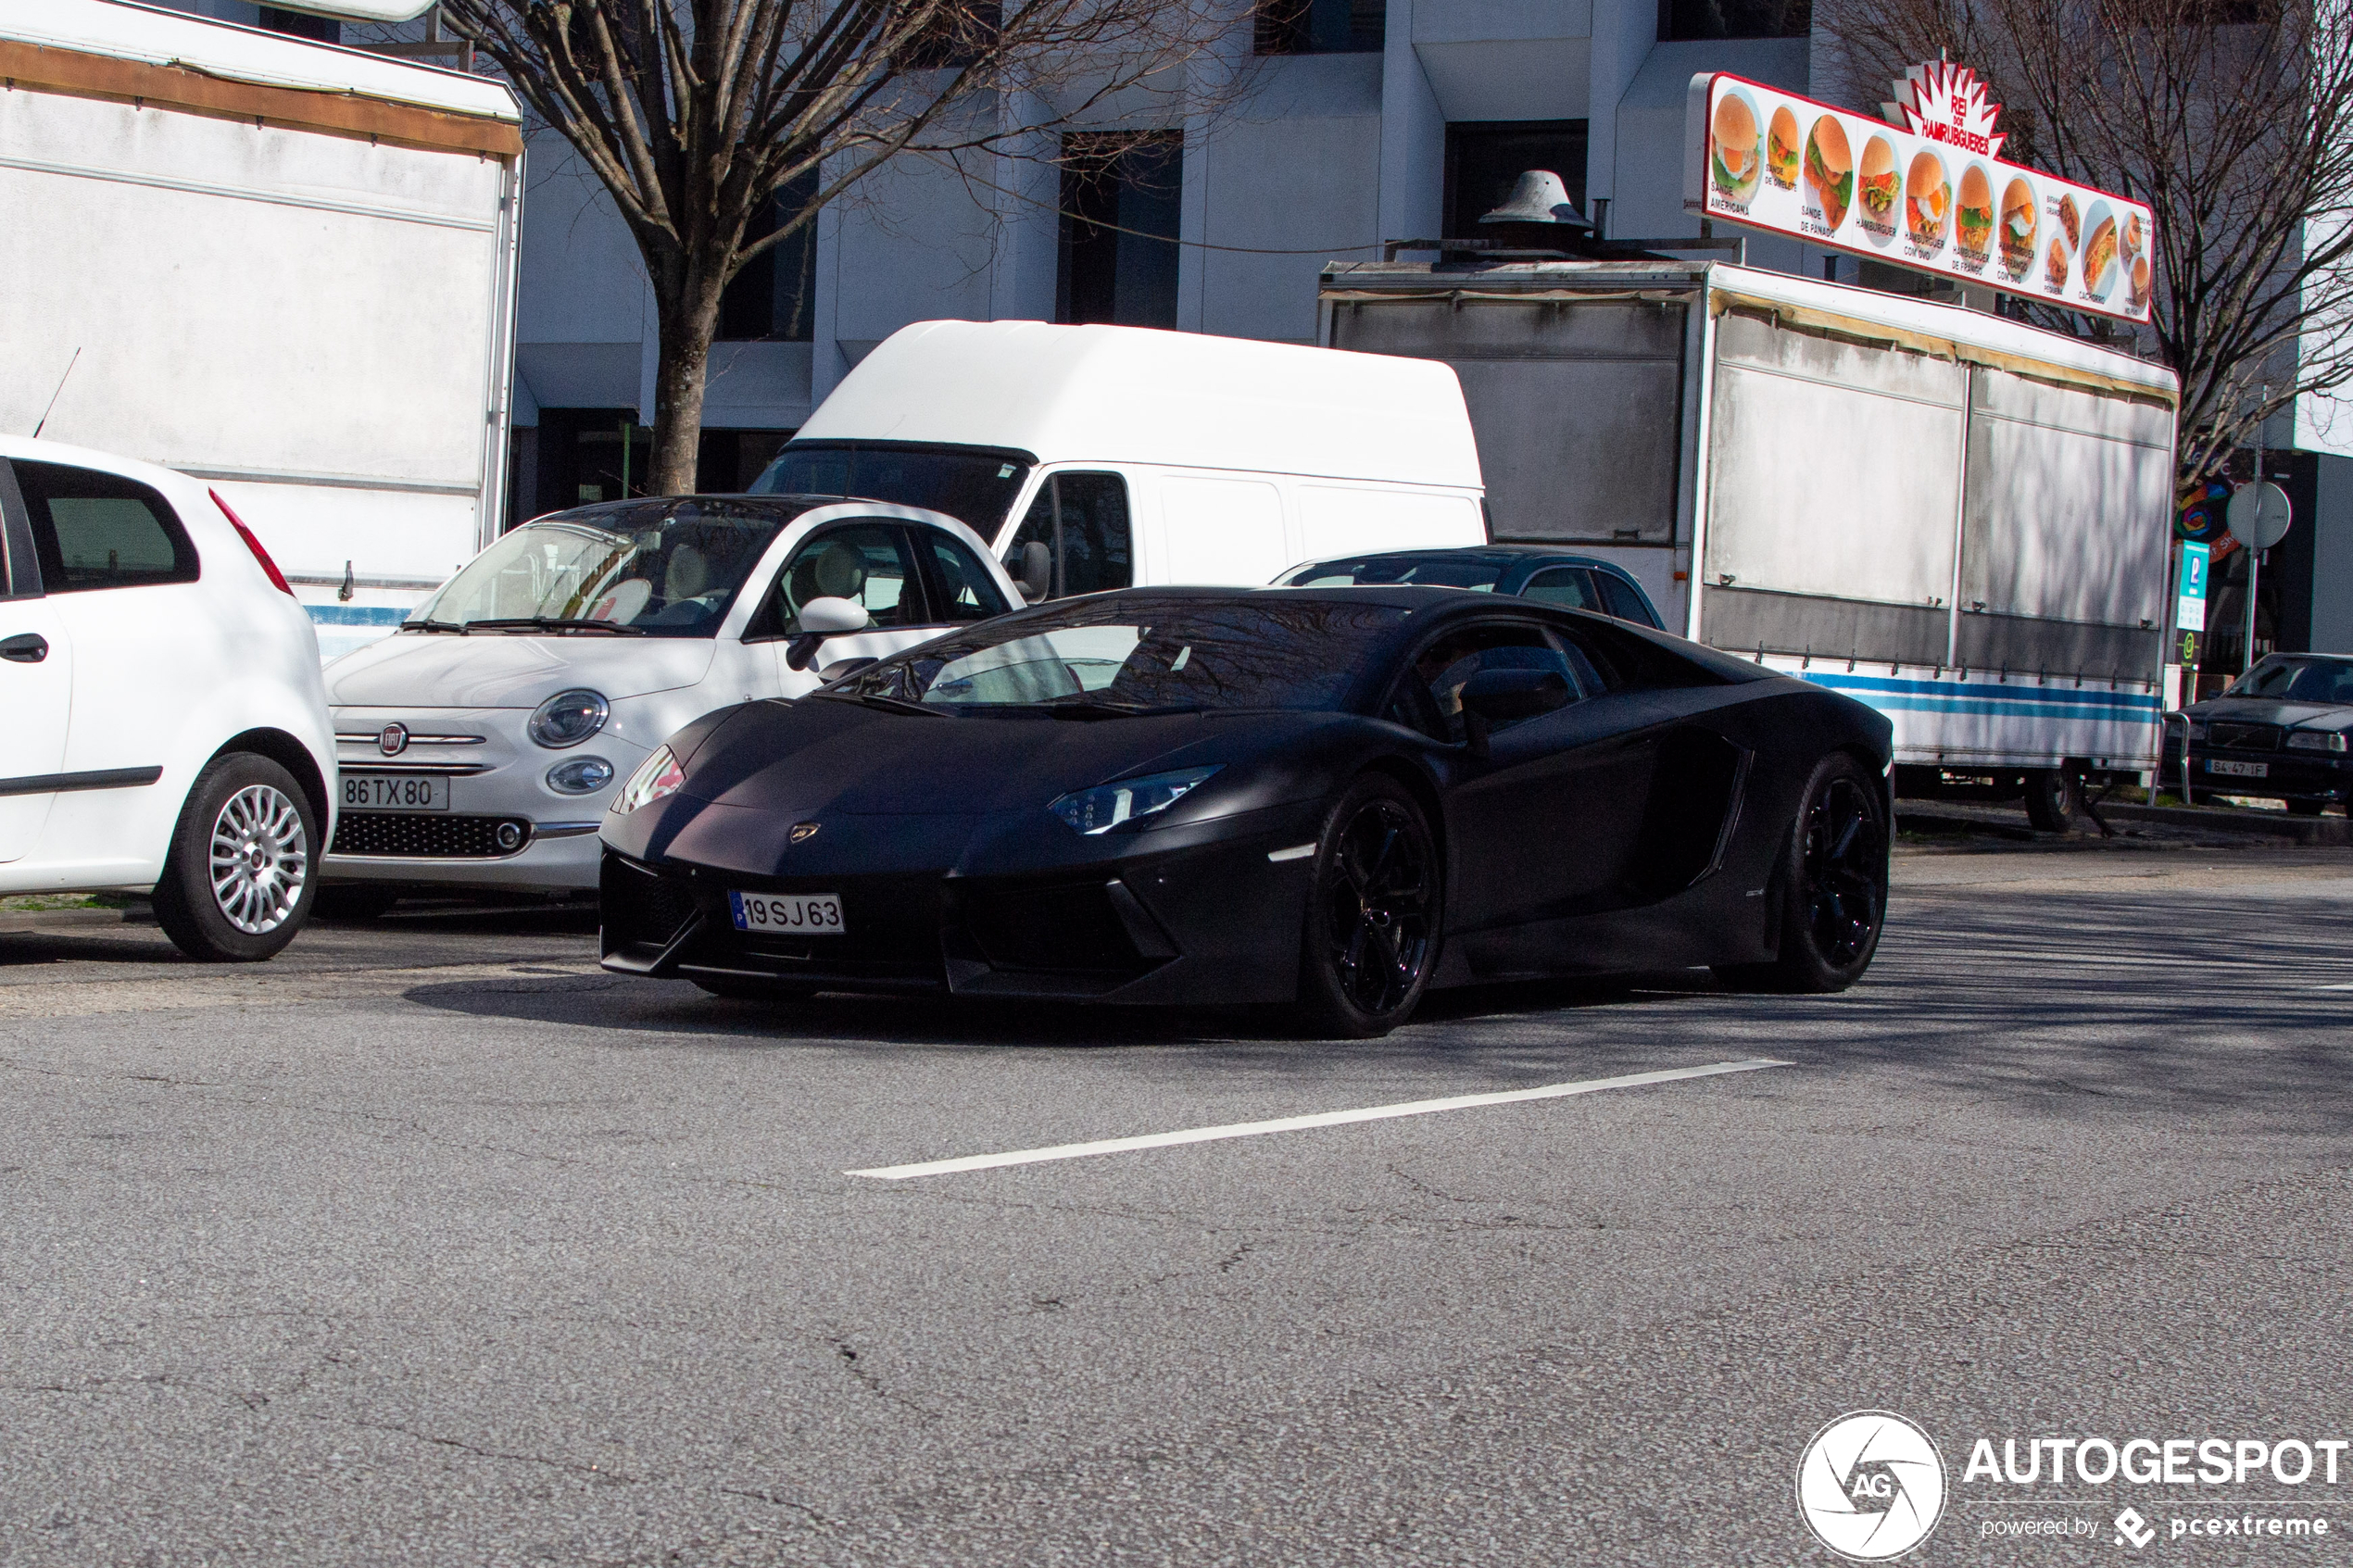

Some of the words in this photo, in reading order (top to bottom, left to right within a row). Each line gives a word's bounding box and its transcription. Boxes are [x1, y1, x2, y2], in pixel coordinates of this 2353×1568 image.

[1951, 94, 1967, 118] REI
[1953, 115, 1963, 127] DOS
[1710, 181, 1733, 196] SANDE
[1765, 176, 1772, 186] DE
[1710, 197, 1750, 217] AMERICANA
[1801, 206, 1821, 220] SANDE
[1800, 221, 1808, 232] DE
[1810, 223, 1835, 239] PANADO
[1856, 218, 1896, 238] HAMBURGUER
[1904, 245, 1917, 257] COM
[1919, 249, 1931, 261] OVO
[1952, 260, 1959, 270] DE
[384, 733, 399, 746] FIAT
